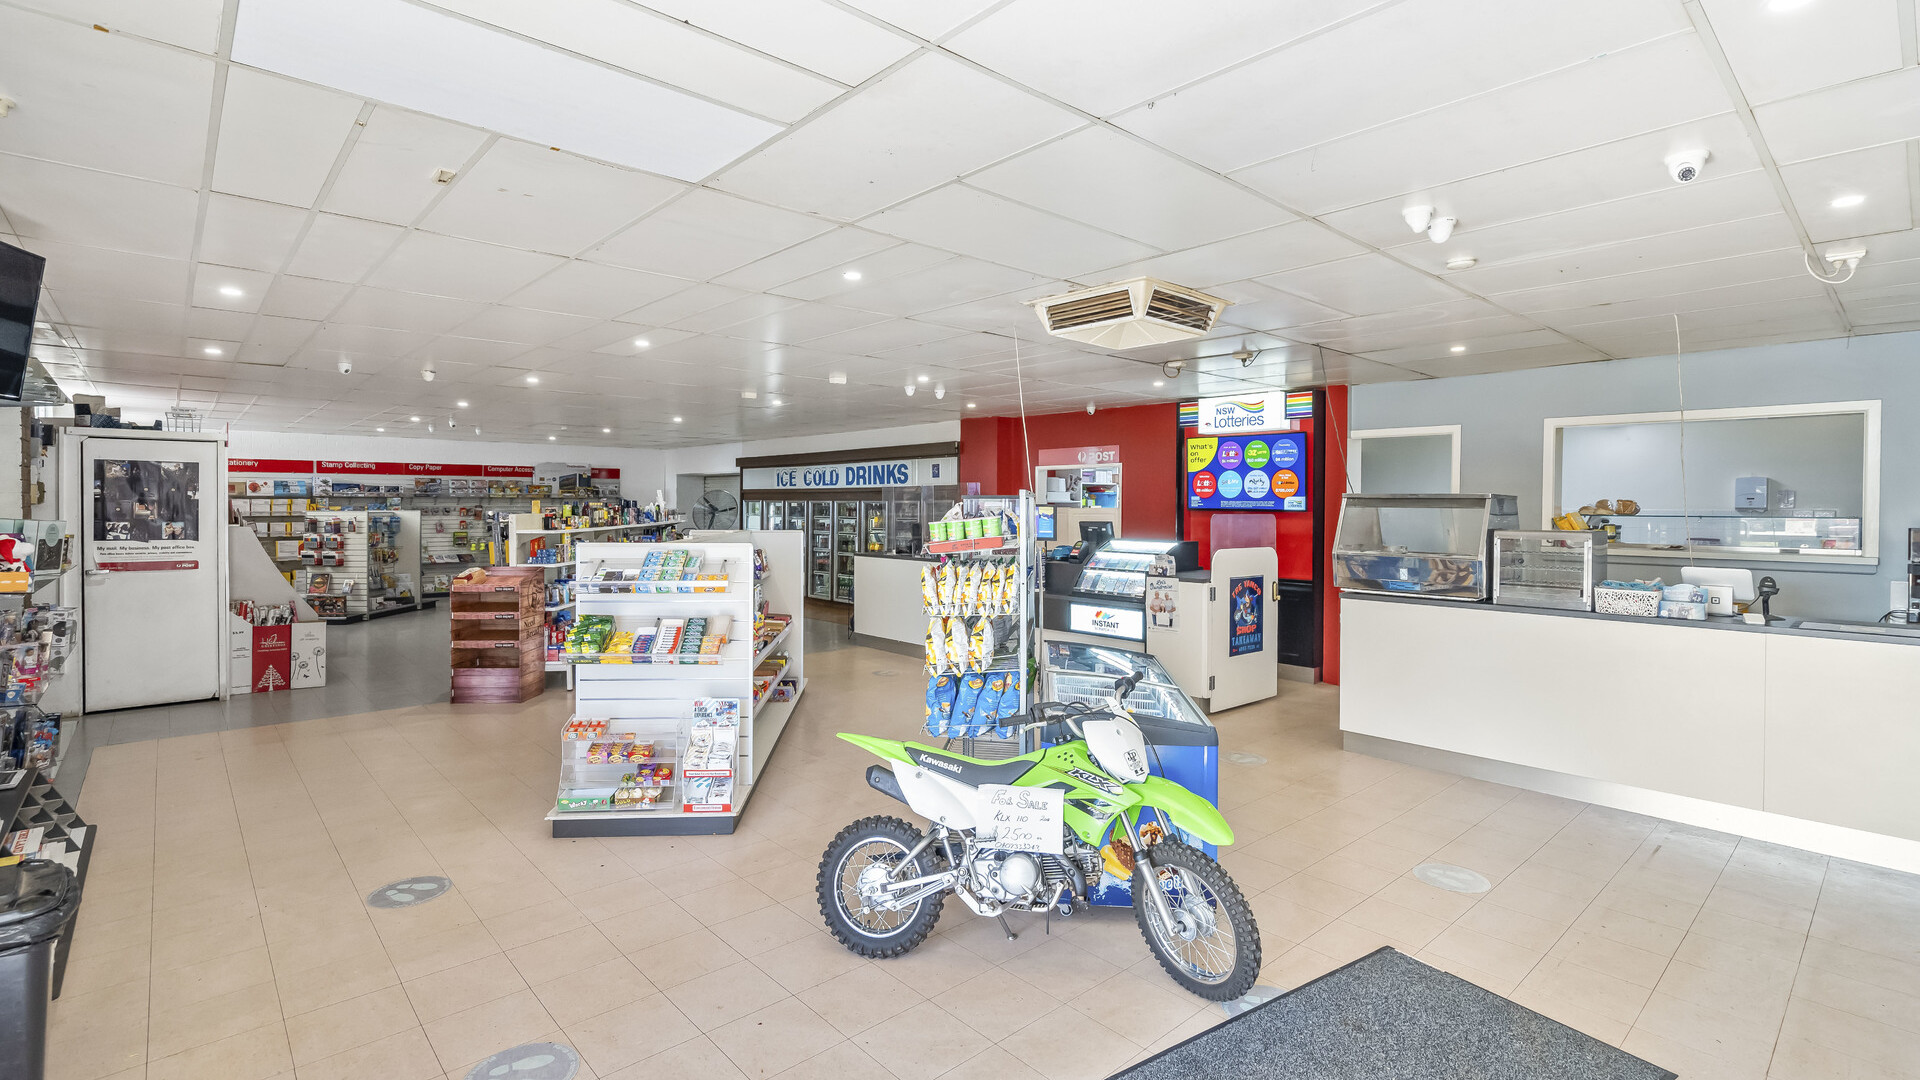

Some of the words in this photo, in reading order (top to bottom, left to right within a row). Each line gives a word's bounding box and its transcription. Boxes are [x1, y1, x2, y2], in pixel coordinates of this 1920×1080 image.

[1216, 407, 1235, 415] NSW
[1214, 414, 1264, 428] Lotteries
[227, 459, 259, 467] ationery
[321, 461, 343, 469] Stamp
[344, 461, 376, 470] Collecting
[408, 463, 424, 471] Copy
[776, 469, 797, 487] ICE
[803, 467, 839, 486] COLD
[845, 463, 909, 486] DRINKS
[1091, 619, 1120, 629] INSTANT
[1236, 624, 1257, 635] SHOP
[1231, 633, 1262, 646] TAKEAWAY
[919, 753, 963, 774] Kawasaki
[993, 810, 1011, 822] KLX
